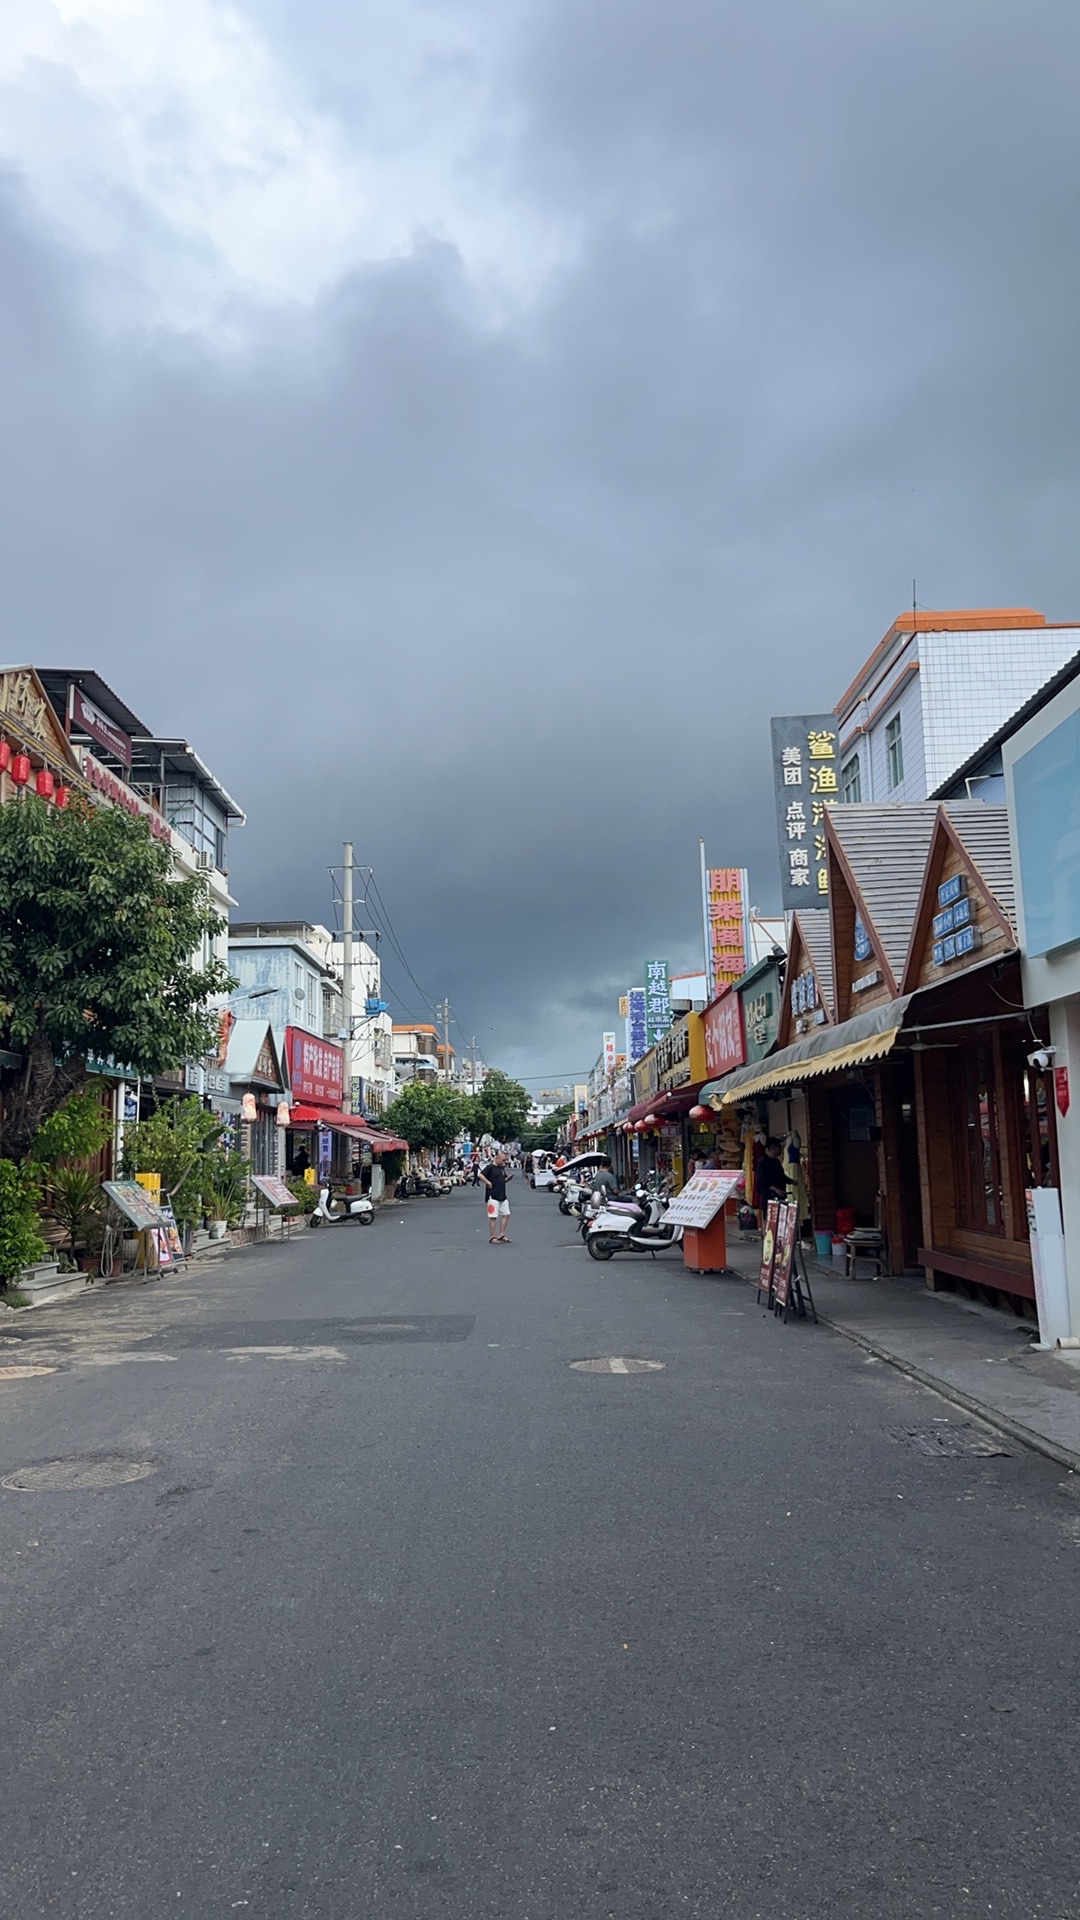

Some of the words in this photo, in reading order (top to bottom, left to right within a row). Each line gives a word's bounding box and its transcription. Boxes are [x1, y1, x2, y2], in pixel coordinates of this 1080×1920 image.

[782, 747, 803, 786] 美团
[786, 801, 807, 840] 点评
[789, 849, 810, 887] 商家
[647, 961, 670, 1014] 南越郡
